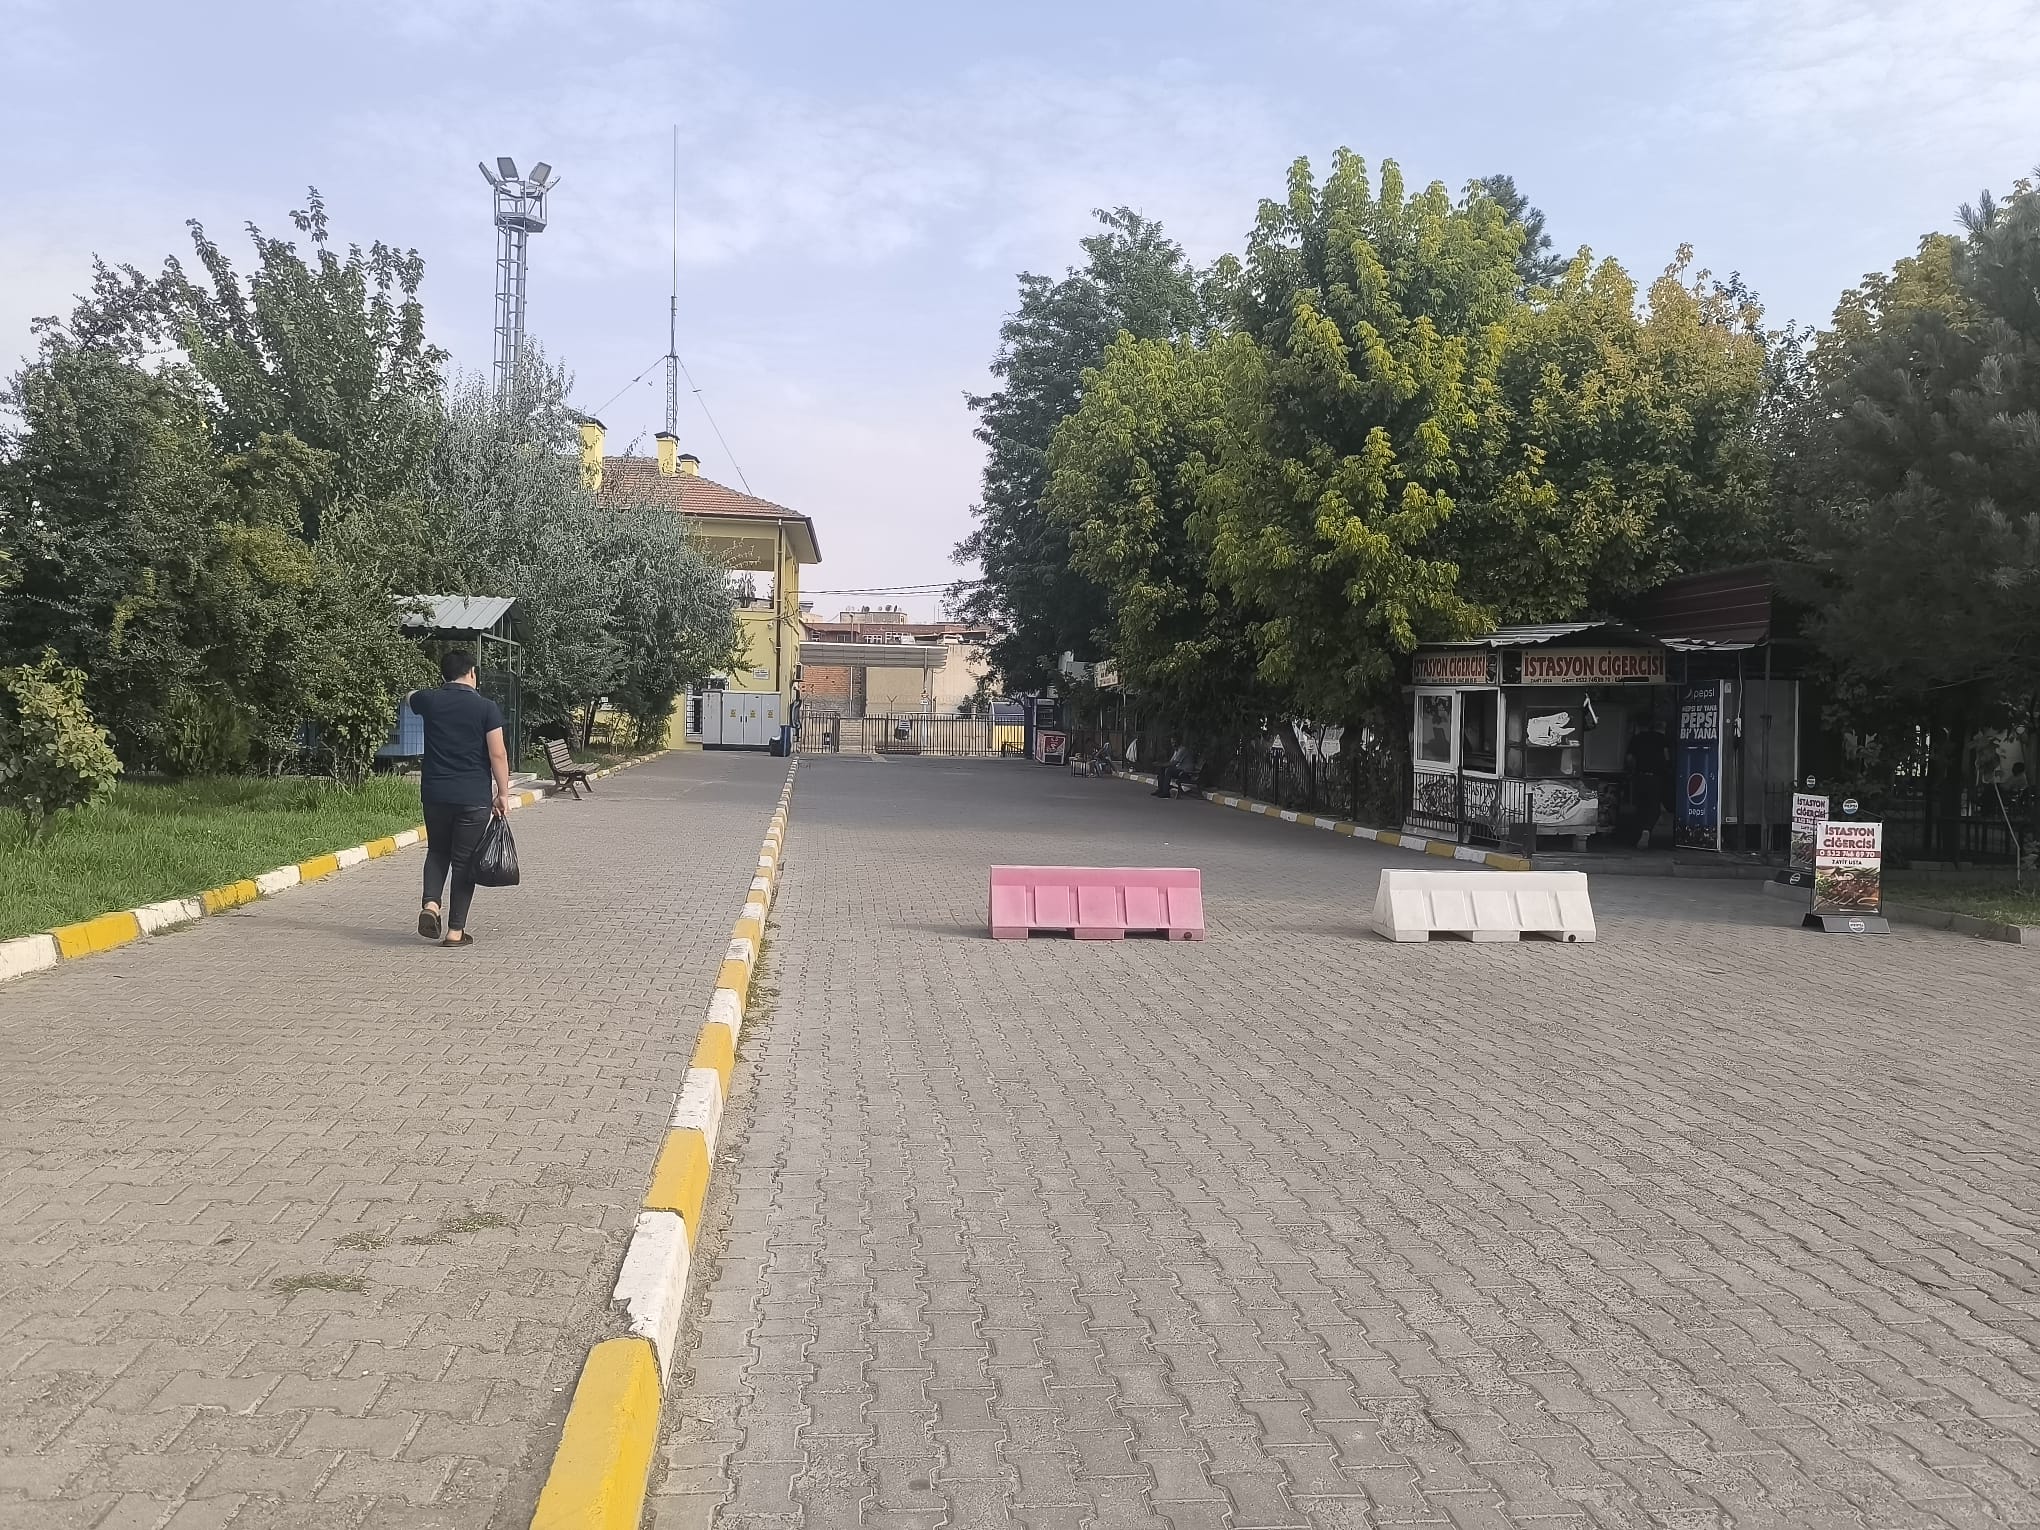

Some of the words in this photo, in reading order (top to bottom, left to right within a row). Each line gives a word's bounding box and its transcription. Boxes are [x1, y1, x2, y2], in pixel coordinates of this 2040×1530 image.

[1524, 652, 1595, 677] İSTASYON
[1693, 687, 1715, 700] pepsi
[1681, 712, 1718, 728] PEPSI
[1693, 727, 1718, 739] YANA
[1797, 796, 1826, 808] İSTASYON
[1825, 824, 1875, 837] İSTASYON
[1823, 836, 1876, 849] CİĞERCİSİ
